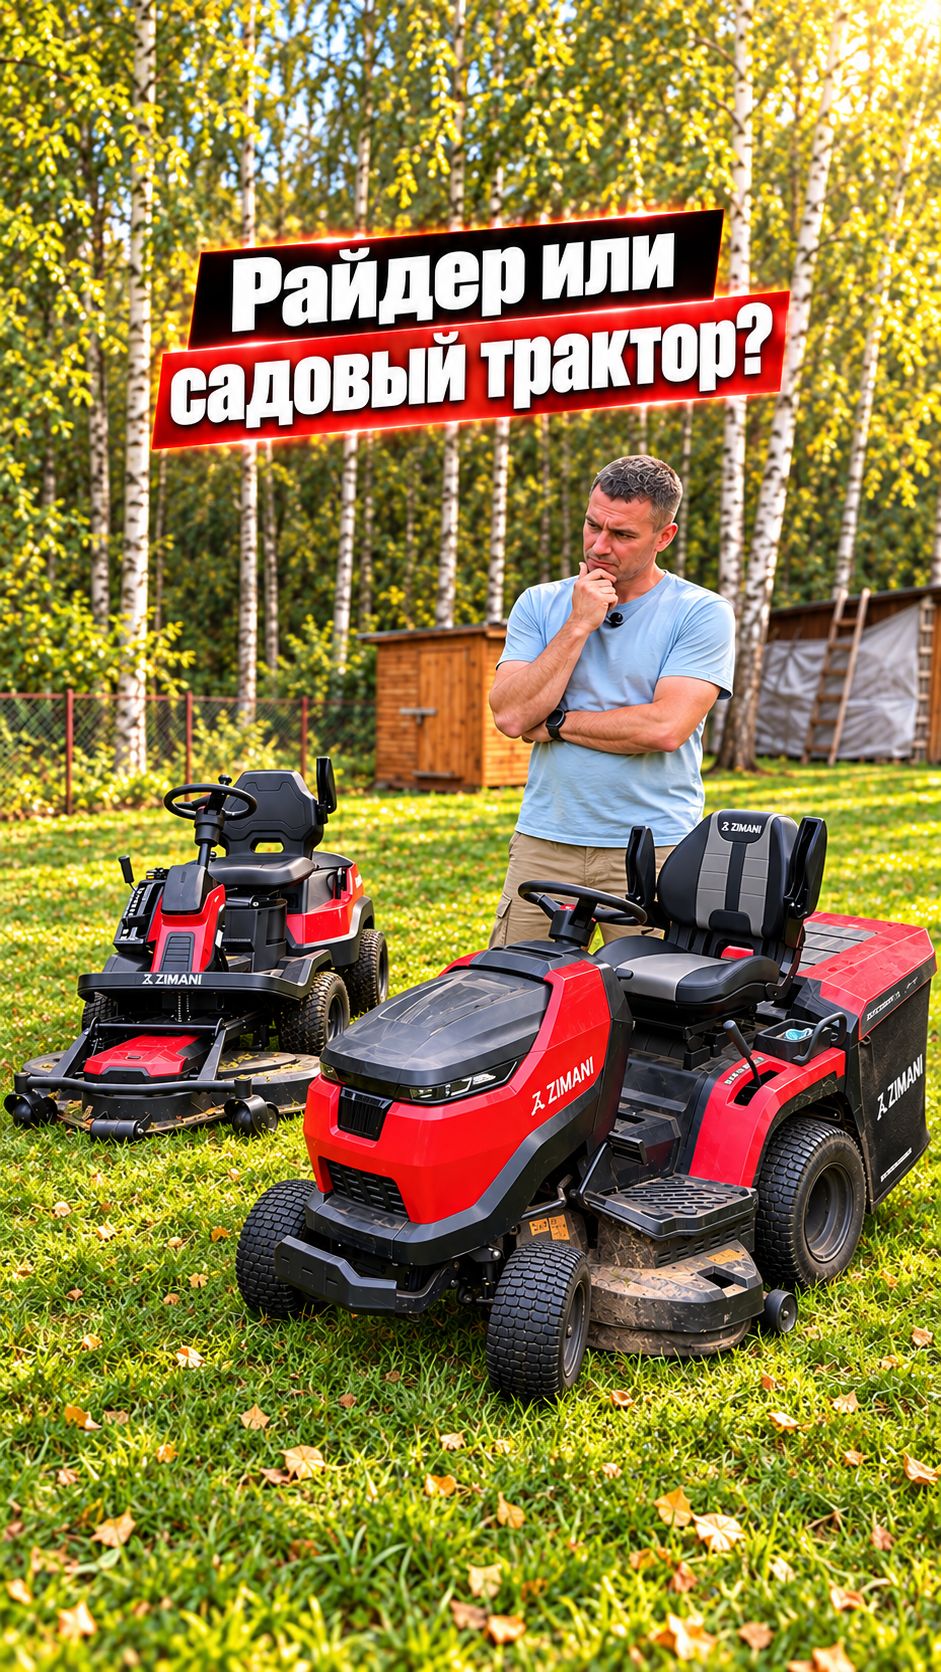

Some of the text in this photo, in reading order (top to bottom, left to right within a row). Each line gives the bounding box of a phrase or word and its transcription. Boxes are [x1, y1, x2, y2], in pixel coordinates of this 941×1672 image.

[731, 822, 762, 834] ZIMANI
[154, 974, 202, 985] ZIMANI
[546, 1056, 594, 1104] ZIMANI
[887, 1053, 924, 1109] ZIMANI
